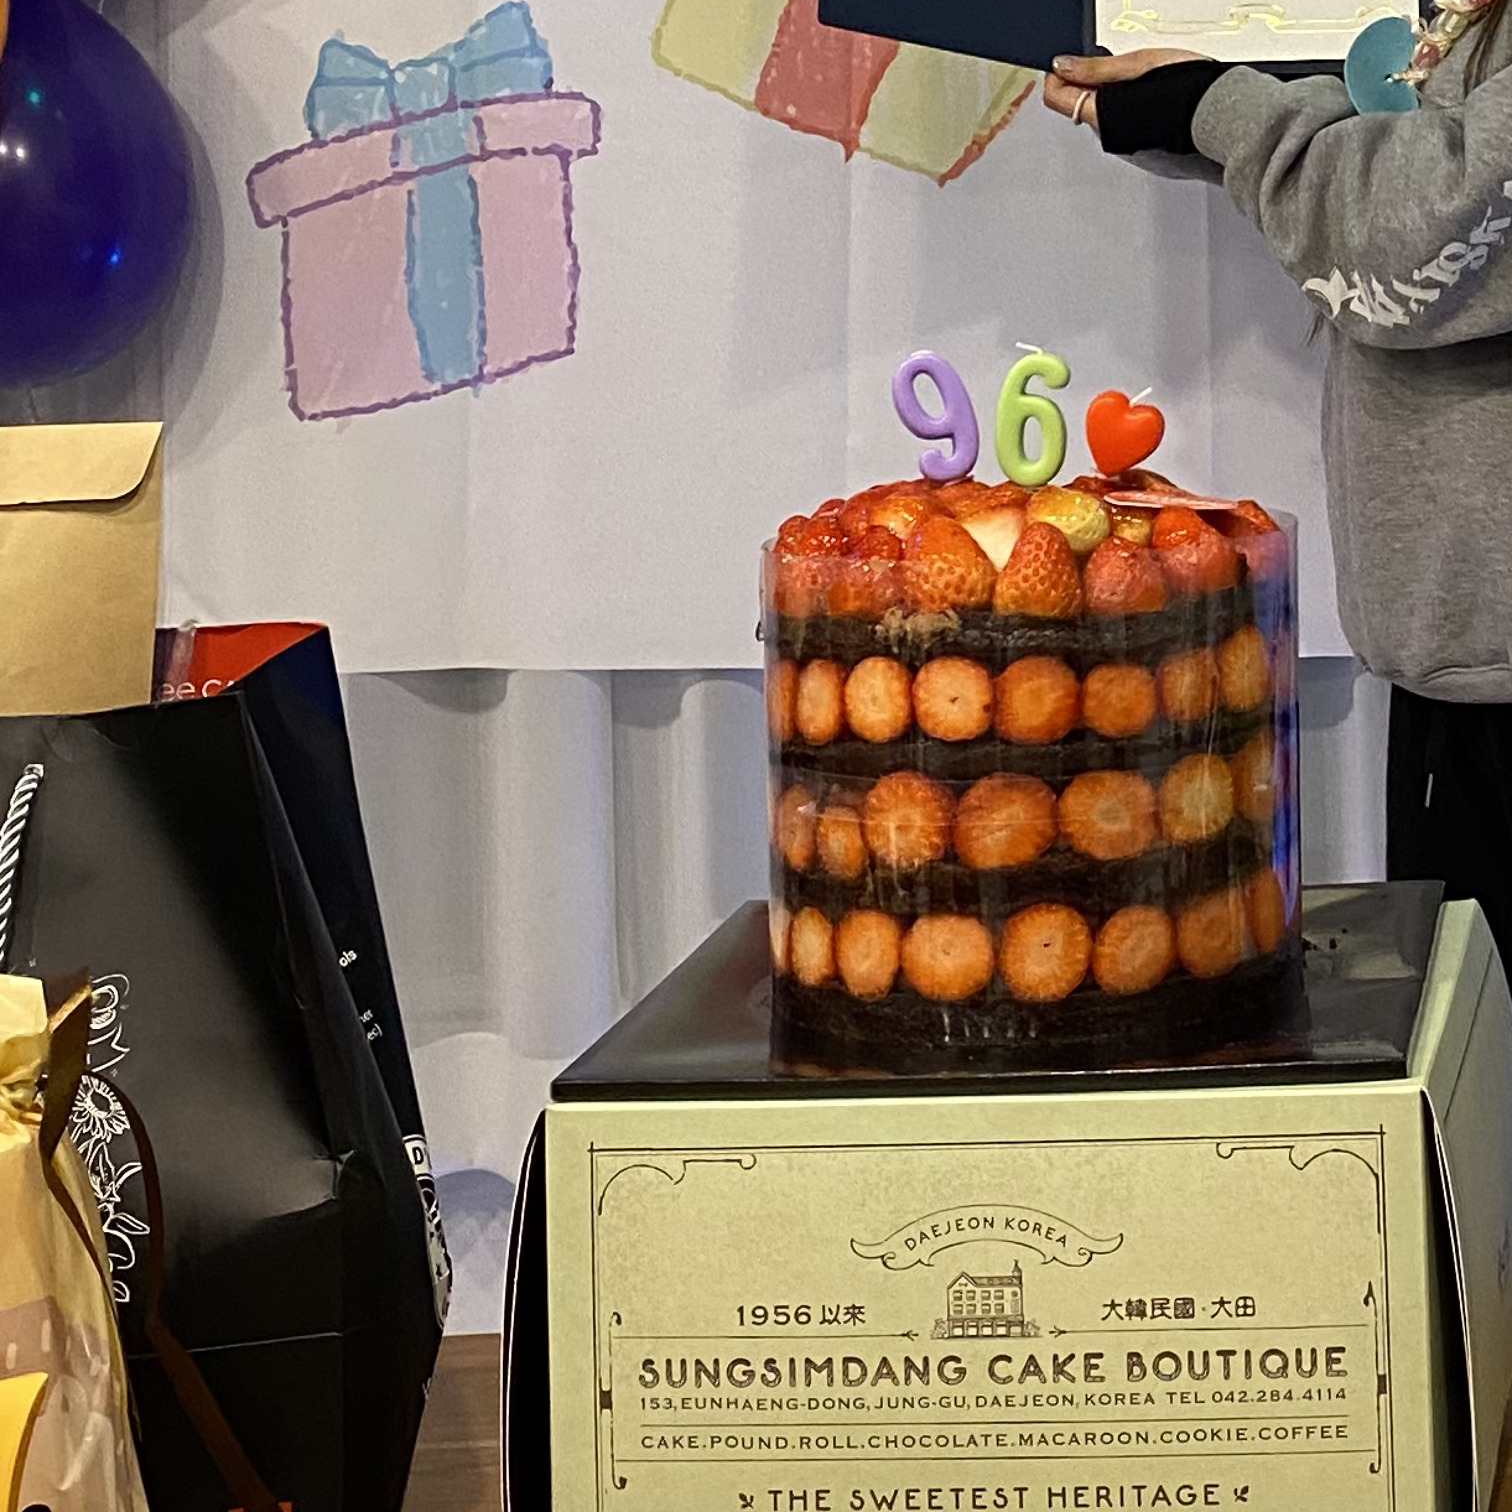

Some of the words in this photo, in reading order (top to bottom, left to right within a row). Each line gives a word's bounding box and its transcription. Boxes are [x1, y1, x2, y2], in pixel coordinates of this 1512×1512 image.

[904, 1216, 996, 1252] DAEJEON
[1004, 1216, 1068, 1248] KOREA
[736, 1303, 812, 1327] 1956
[818, 1303, 867, 1326] 以來
[637, 1354, 968, 1389] SUNGSIMDANG
[987, 1351, 1107, 1385] CAKE
[1125, 1345, 1349, 1383] BOUTIQUE
[1166, 1390, 1206, 1405] TEL
[1211, 1387, 1347, 1404] 042.284.4114
[768, 1487, 832, 1512] THE
[848, 1485, 1029, 1512] SWEETEST
[1047, 1482, 1221, 1510] HERITAGE
